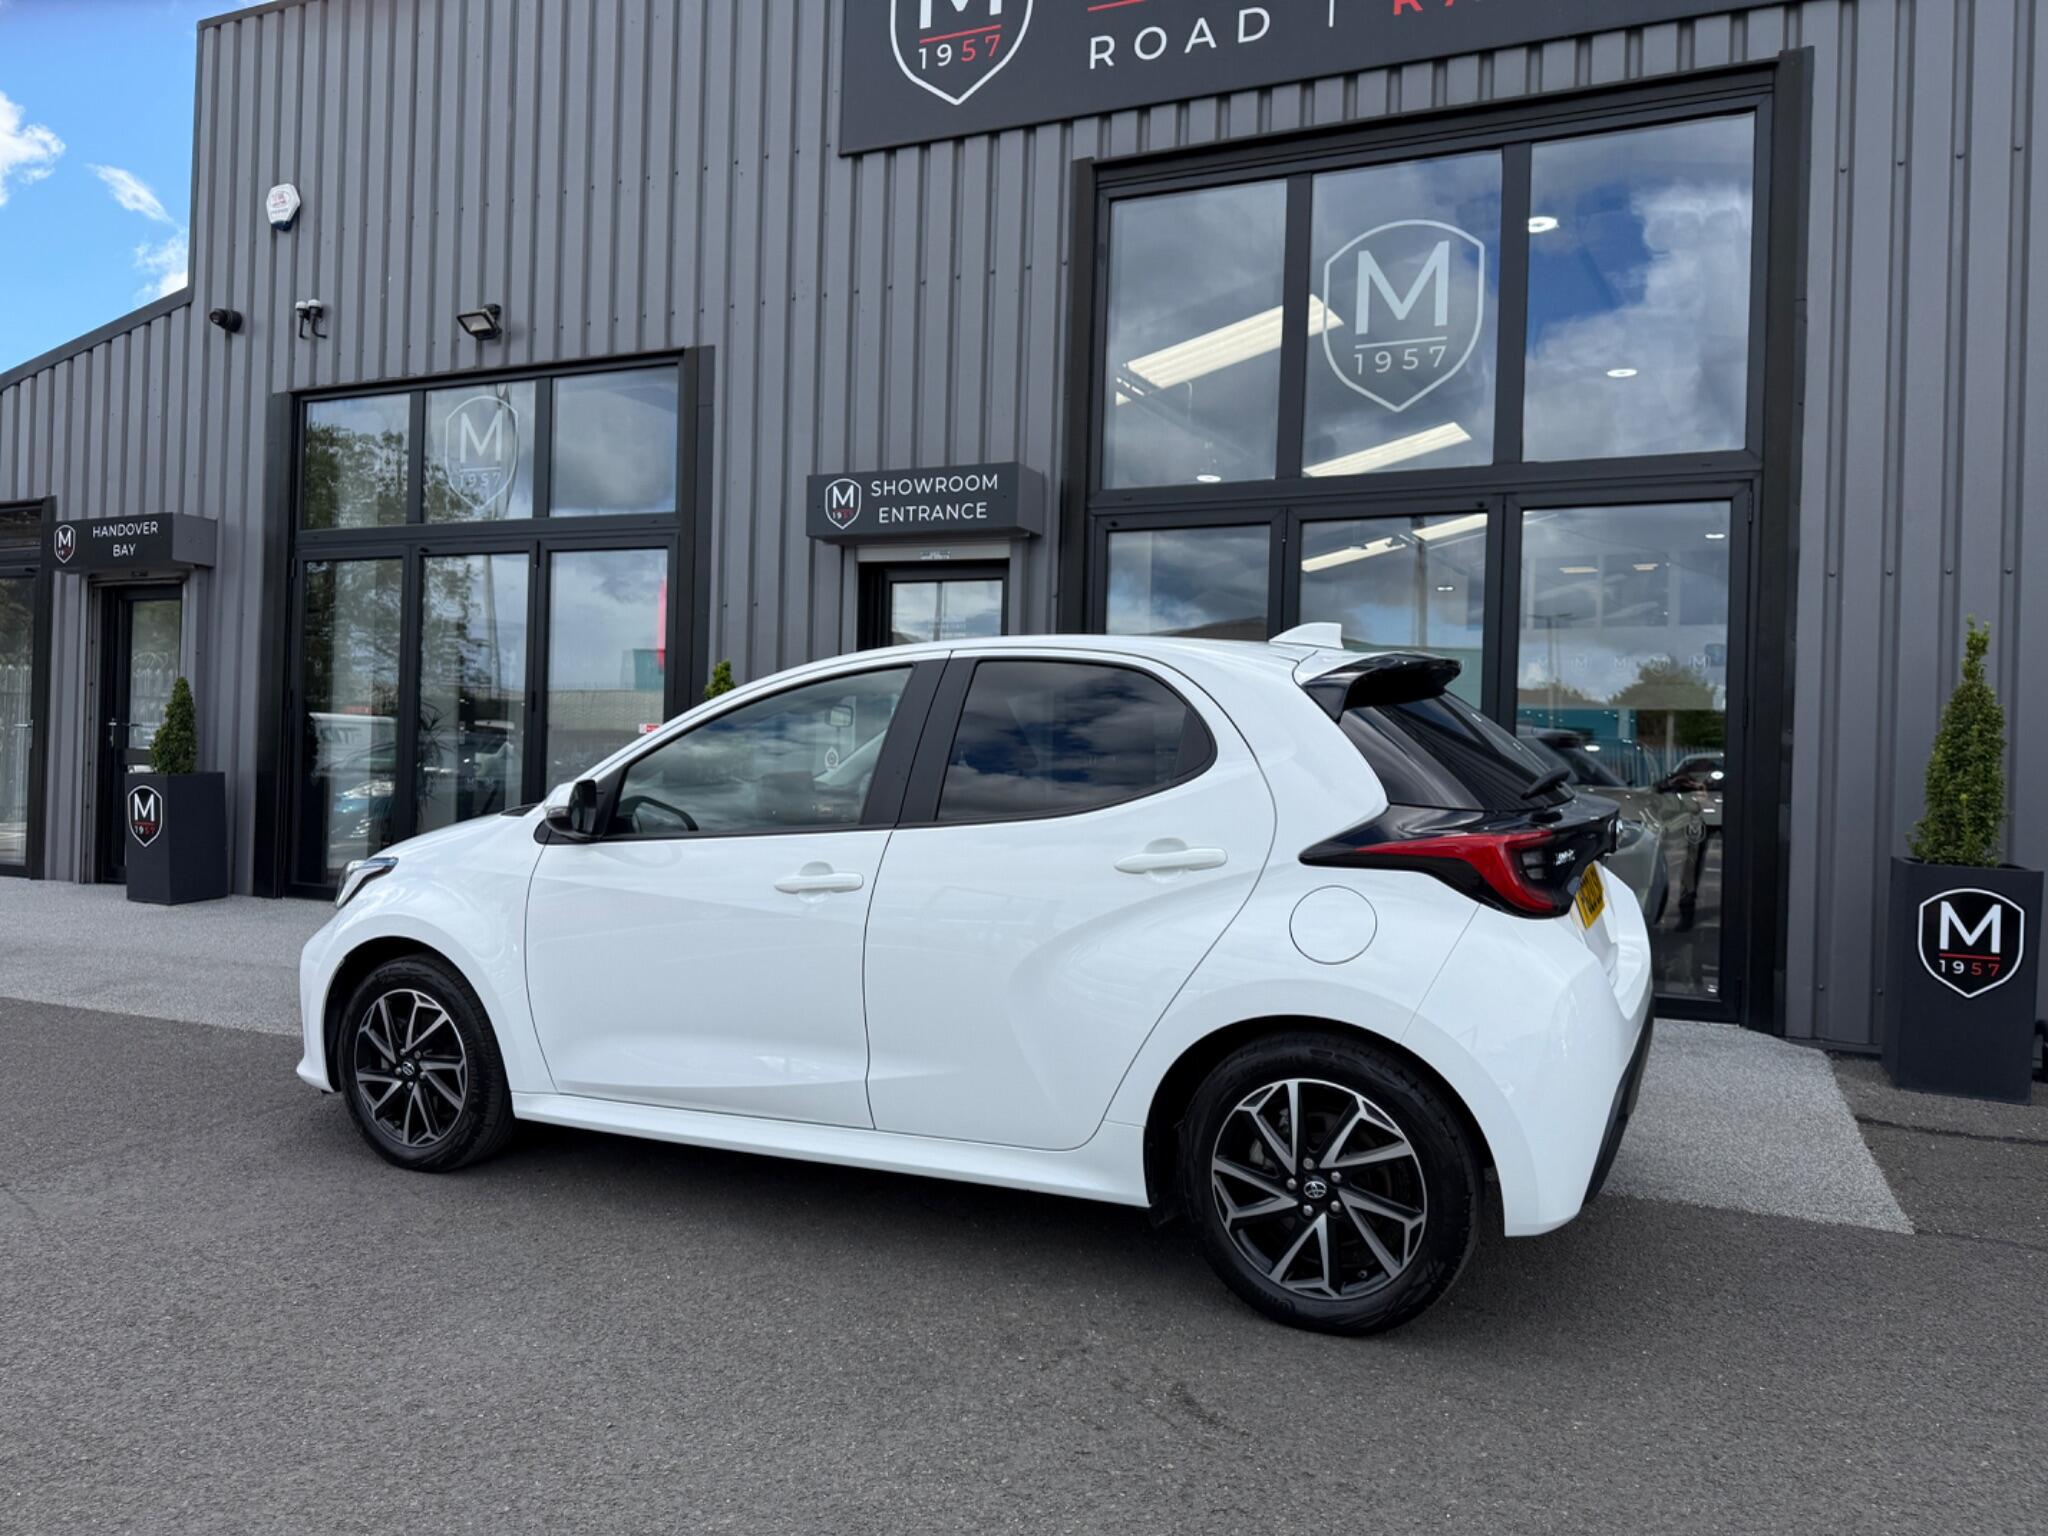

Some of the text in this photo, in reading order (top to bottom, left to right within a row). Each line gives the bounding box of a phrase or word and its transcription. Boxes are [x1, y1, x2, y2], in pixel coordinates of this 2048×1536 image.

[1089, 6, 1271, 70] ROAD
[918, 34, 1001, 70] 1957
[1355, 240, 1450, 335] M
[1354, 345, 1446, 375] 1957
[459, 409, 503, 463] M
[459, 472, 501, 488] 1957
[871, 474, 998, 497] SHOWROOM
[832, 484, 854, 509] M
[878, 501, 988, 524] ENTRANCE
[58, 530, 71, 548] M
[92, 521, 159, 538] HANDOVER
[112, 543, 137, 557] BAY
[134, 792, 155, 822] M
[1939, 900, 2002, 954] M
[1938, 959, 2001, 977] 1957
